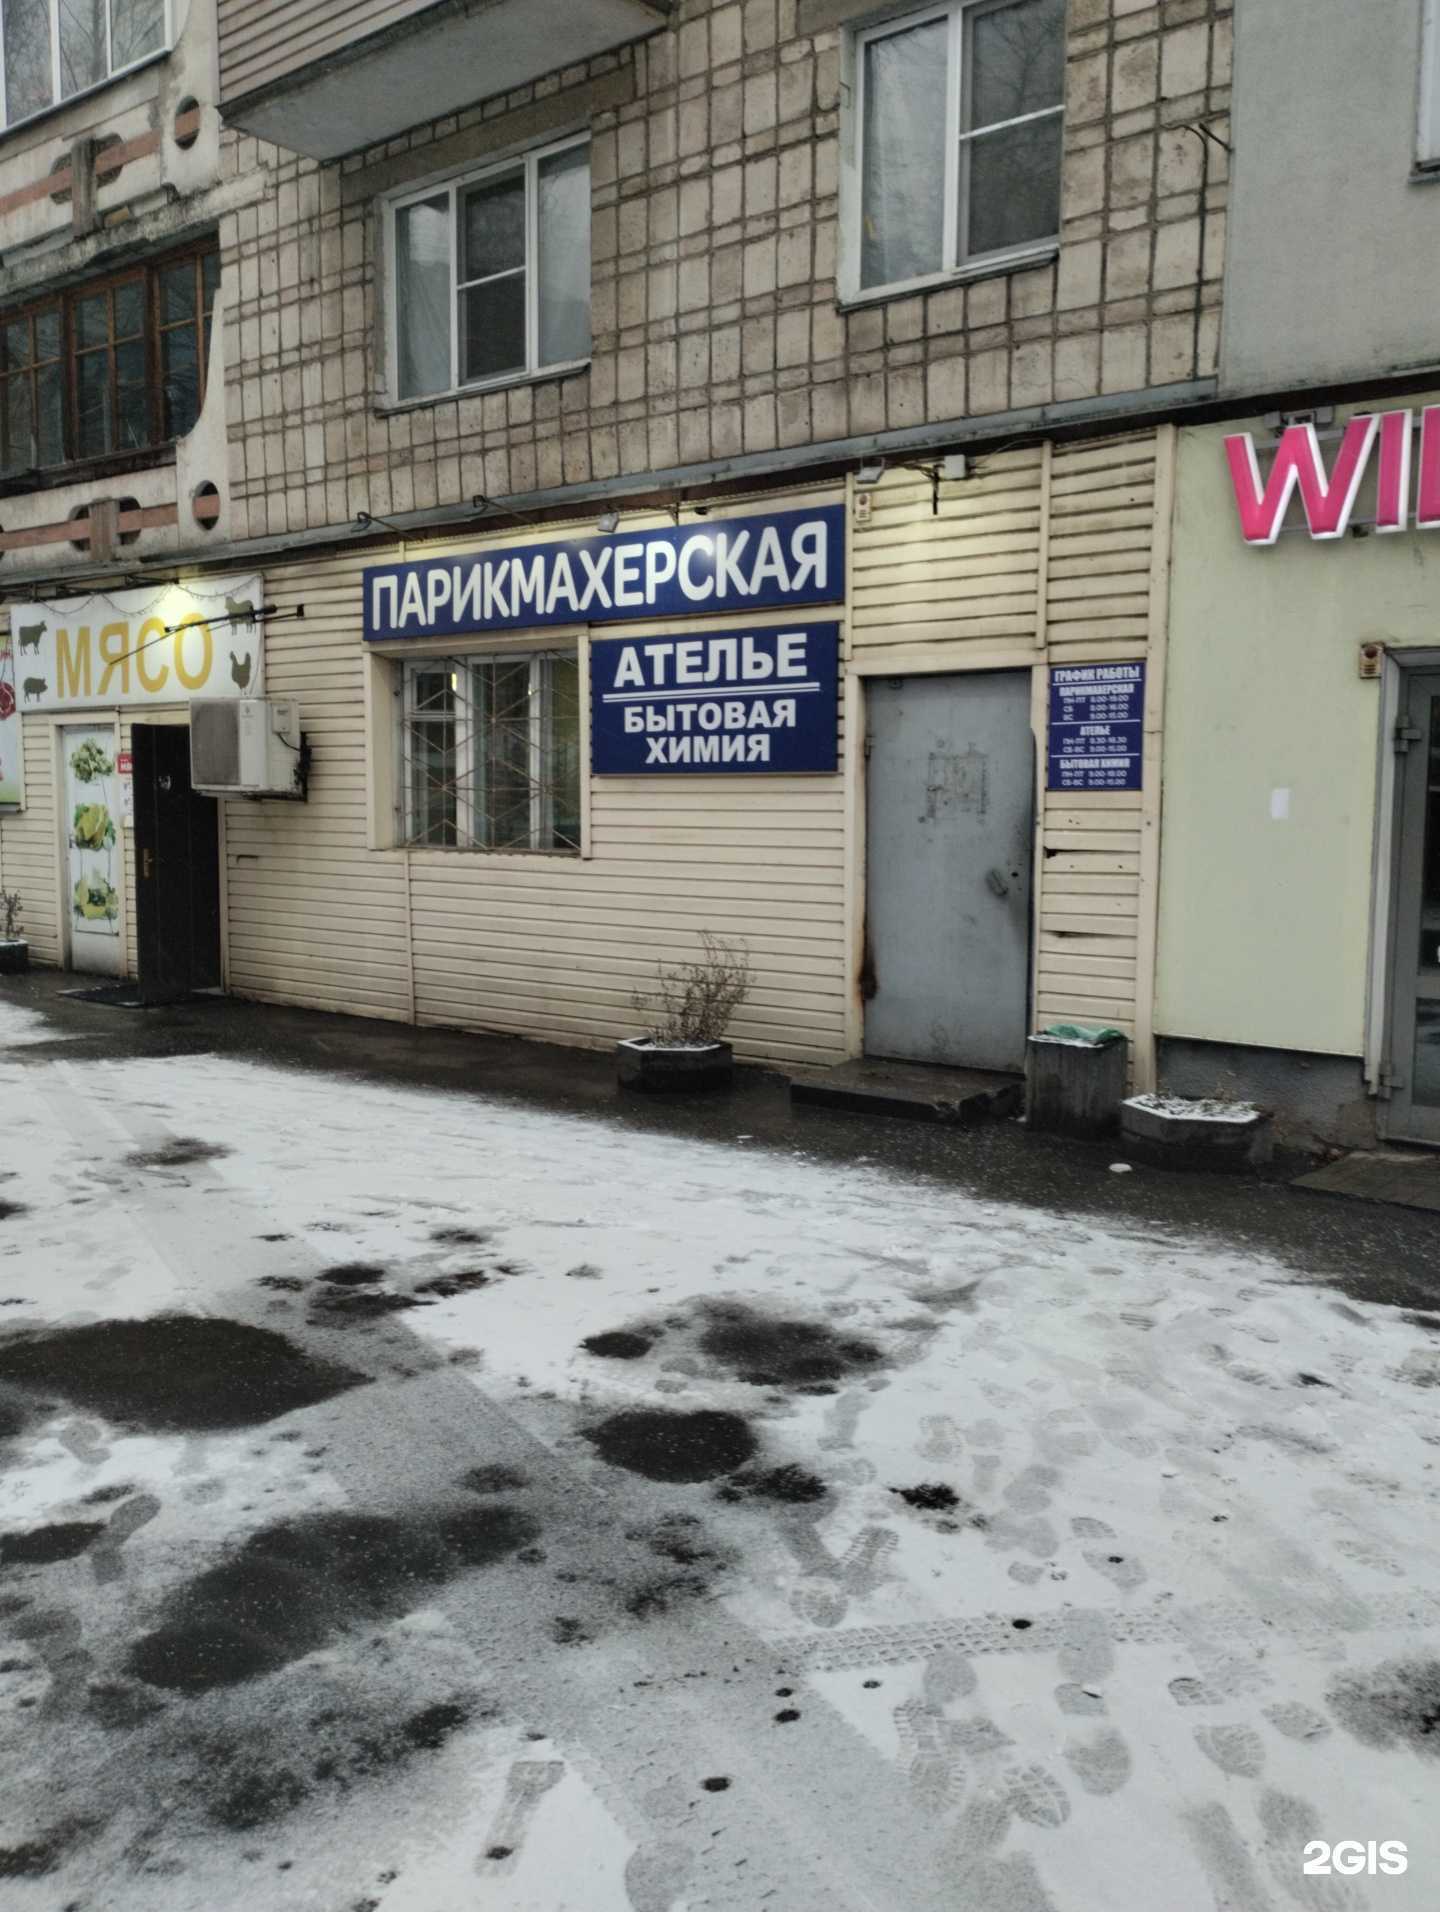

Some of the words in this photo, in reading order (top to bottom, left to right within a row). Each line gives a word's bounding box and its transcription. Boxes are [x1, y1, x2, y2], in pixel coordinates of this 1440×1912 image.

[372, 520, 828, 631] ПАРИКМАХЕРСКАЯ
[55, 612, 214, 699] МЯСО
[613, 632, 808, 688] АТЕЛЬЕ
[1054, 668, 1096, 682] ГРАФИК
[1096, 665, 1140, 680] РАБОТЫ
[1059, 683, 1135, 697] ПАРИКМАХЕРСКАЯ
[624, 699, 796, 733] БЫТОВАЯ
[1080, 725, 1110, 736] АТЕЛЬЕ
[645, 733, 771, 764] ХИМИЯ
[1060, 759, 1100, 769] БЫТОВАЯ
[1100, 758, 1130, 768] ХИМИЯ
